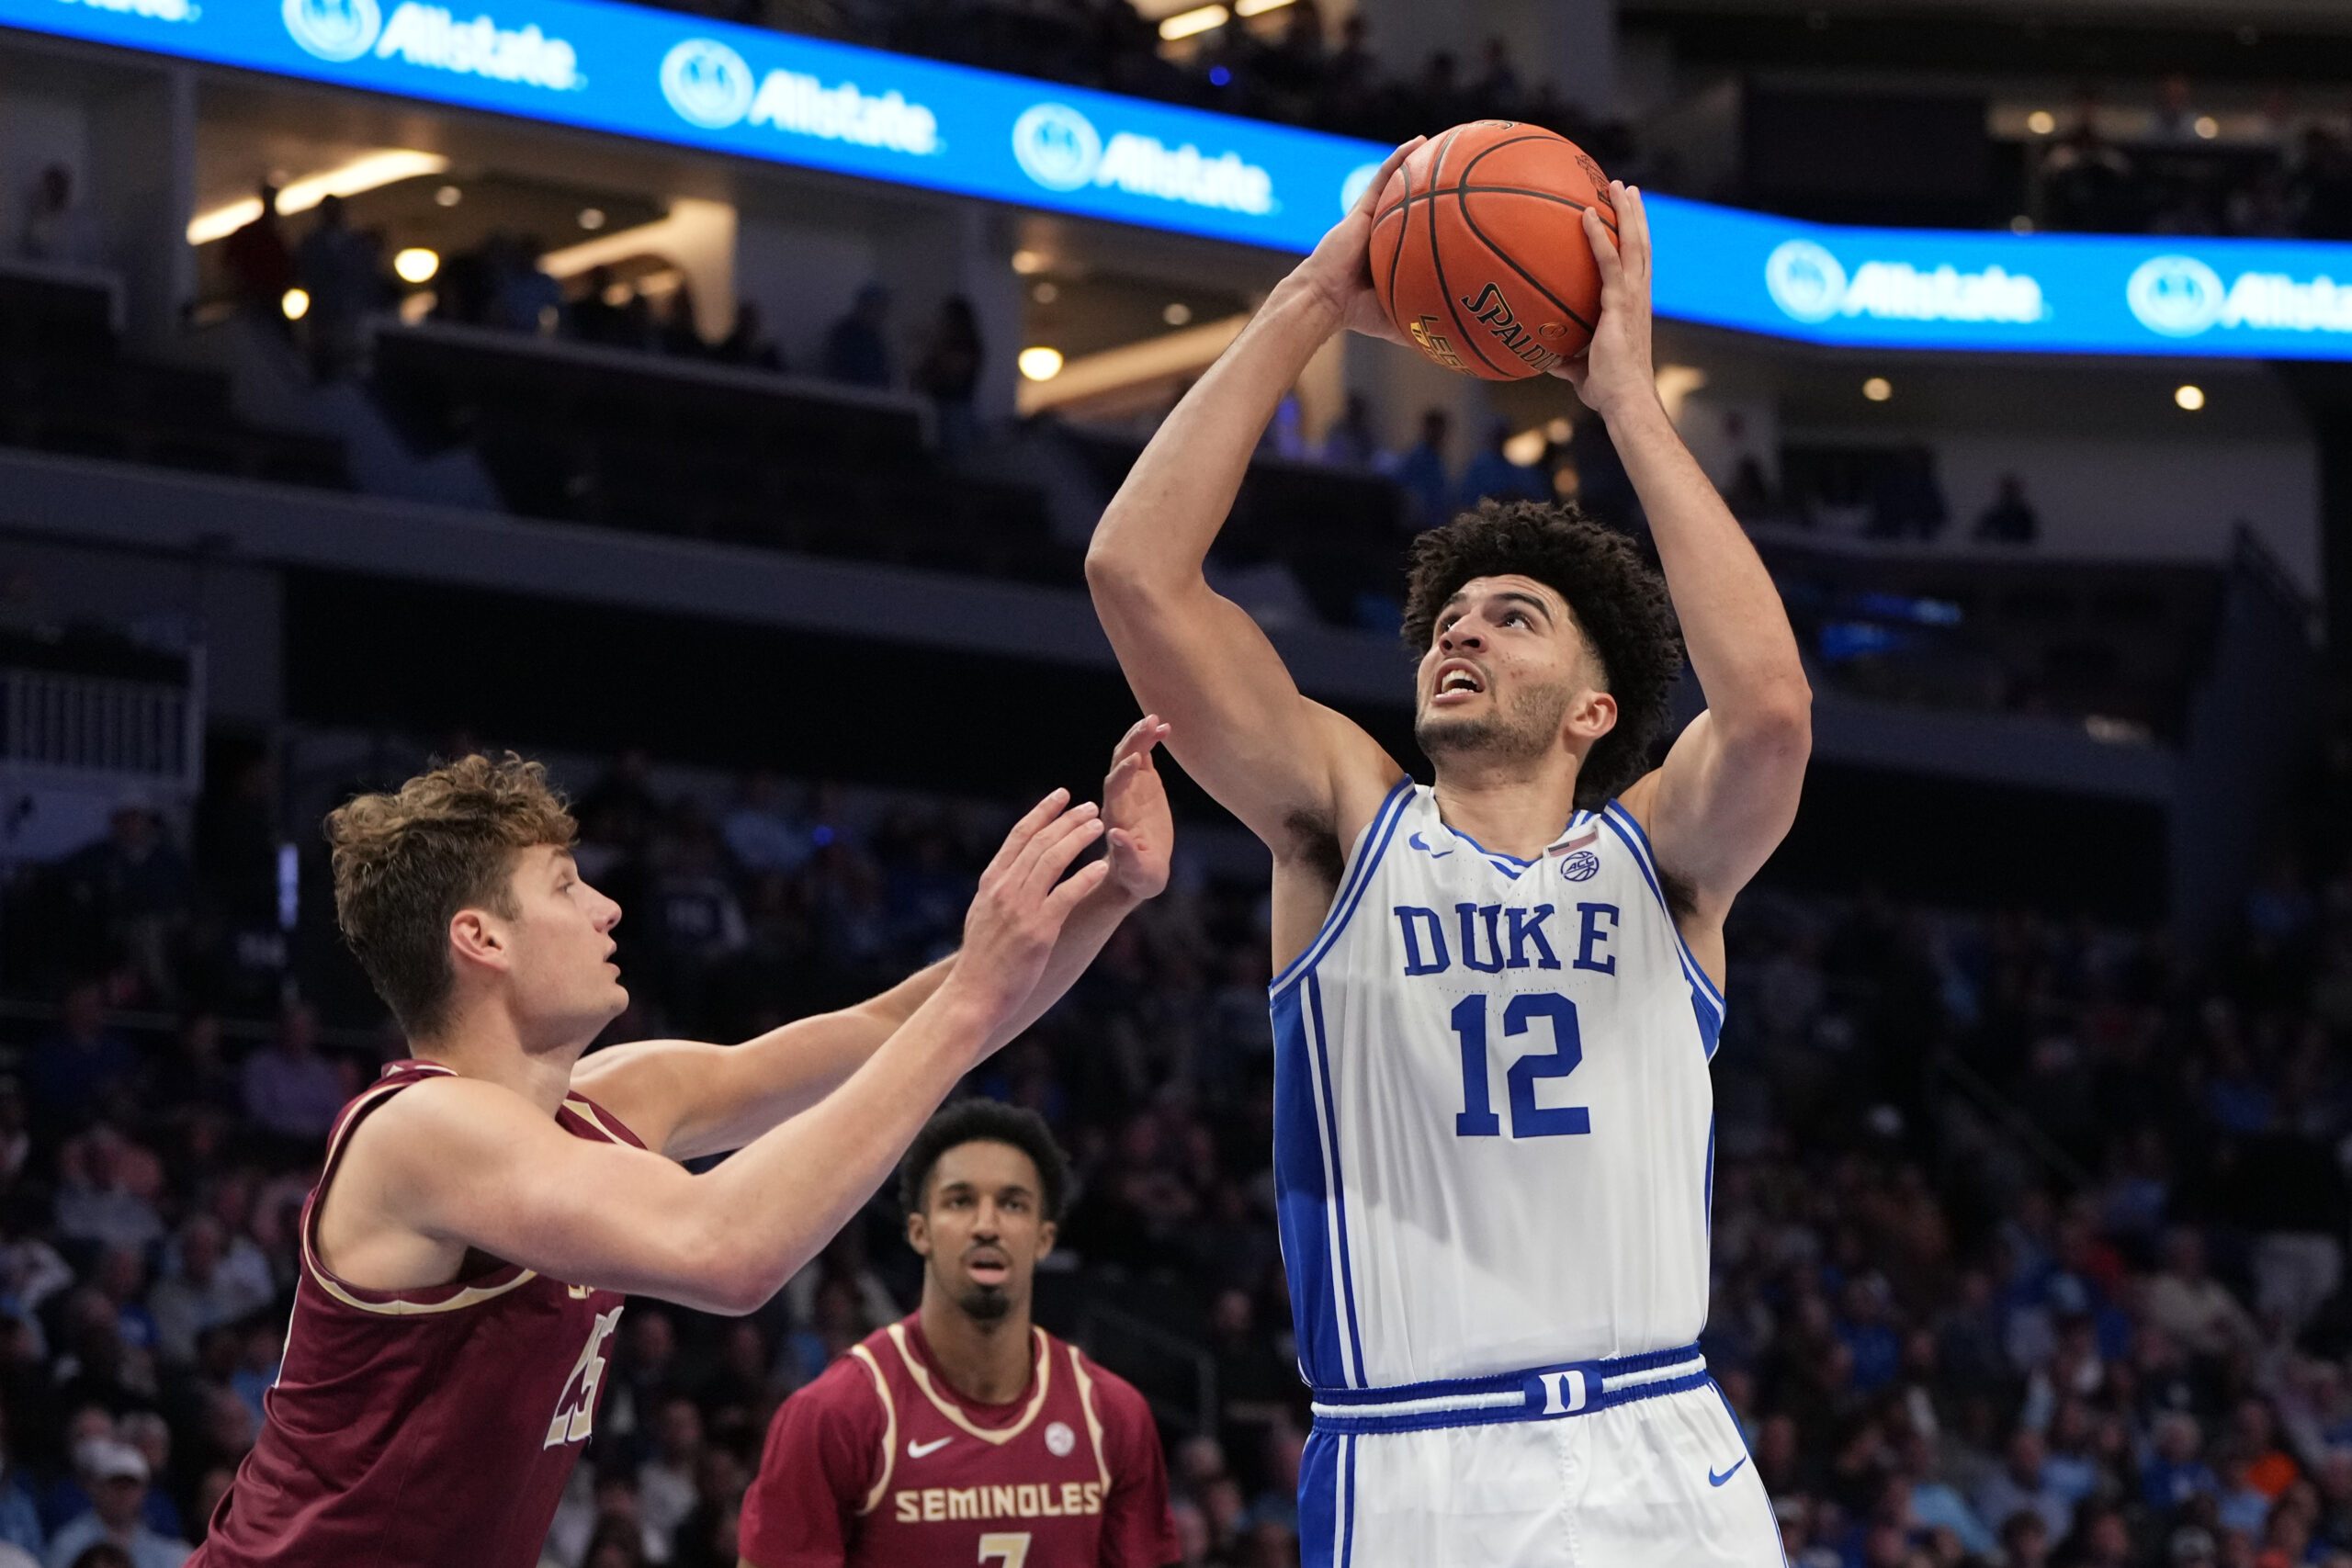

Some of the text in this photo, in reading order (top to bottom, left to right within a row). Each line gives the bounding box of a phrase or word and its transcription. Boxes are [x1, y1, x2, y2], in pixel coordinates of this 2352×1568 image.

[375, 2, 577, 91] Allstate
[748, 68, 938, 156] Allstate
[1094, 131, 1273, 215] Allstate
[1840, 260, 2043, 323] Allstate
[1394, 903, 1620, 976] DUKE
[1451, 992, 1591, 1139] 12
[895, 1482, 1102, 1523] SEMINOLES
[978, 1531, 1032, 1568] 7
